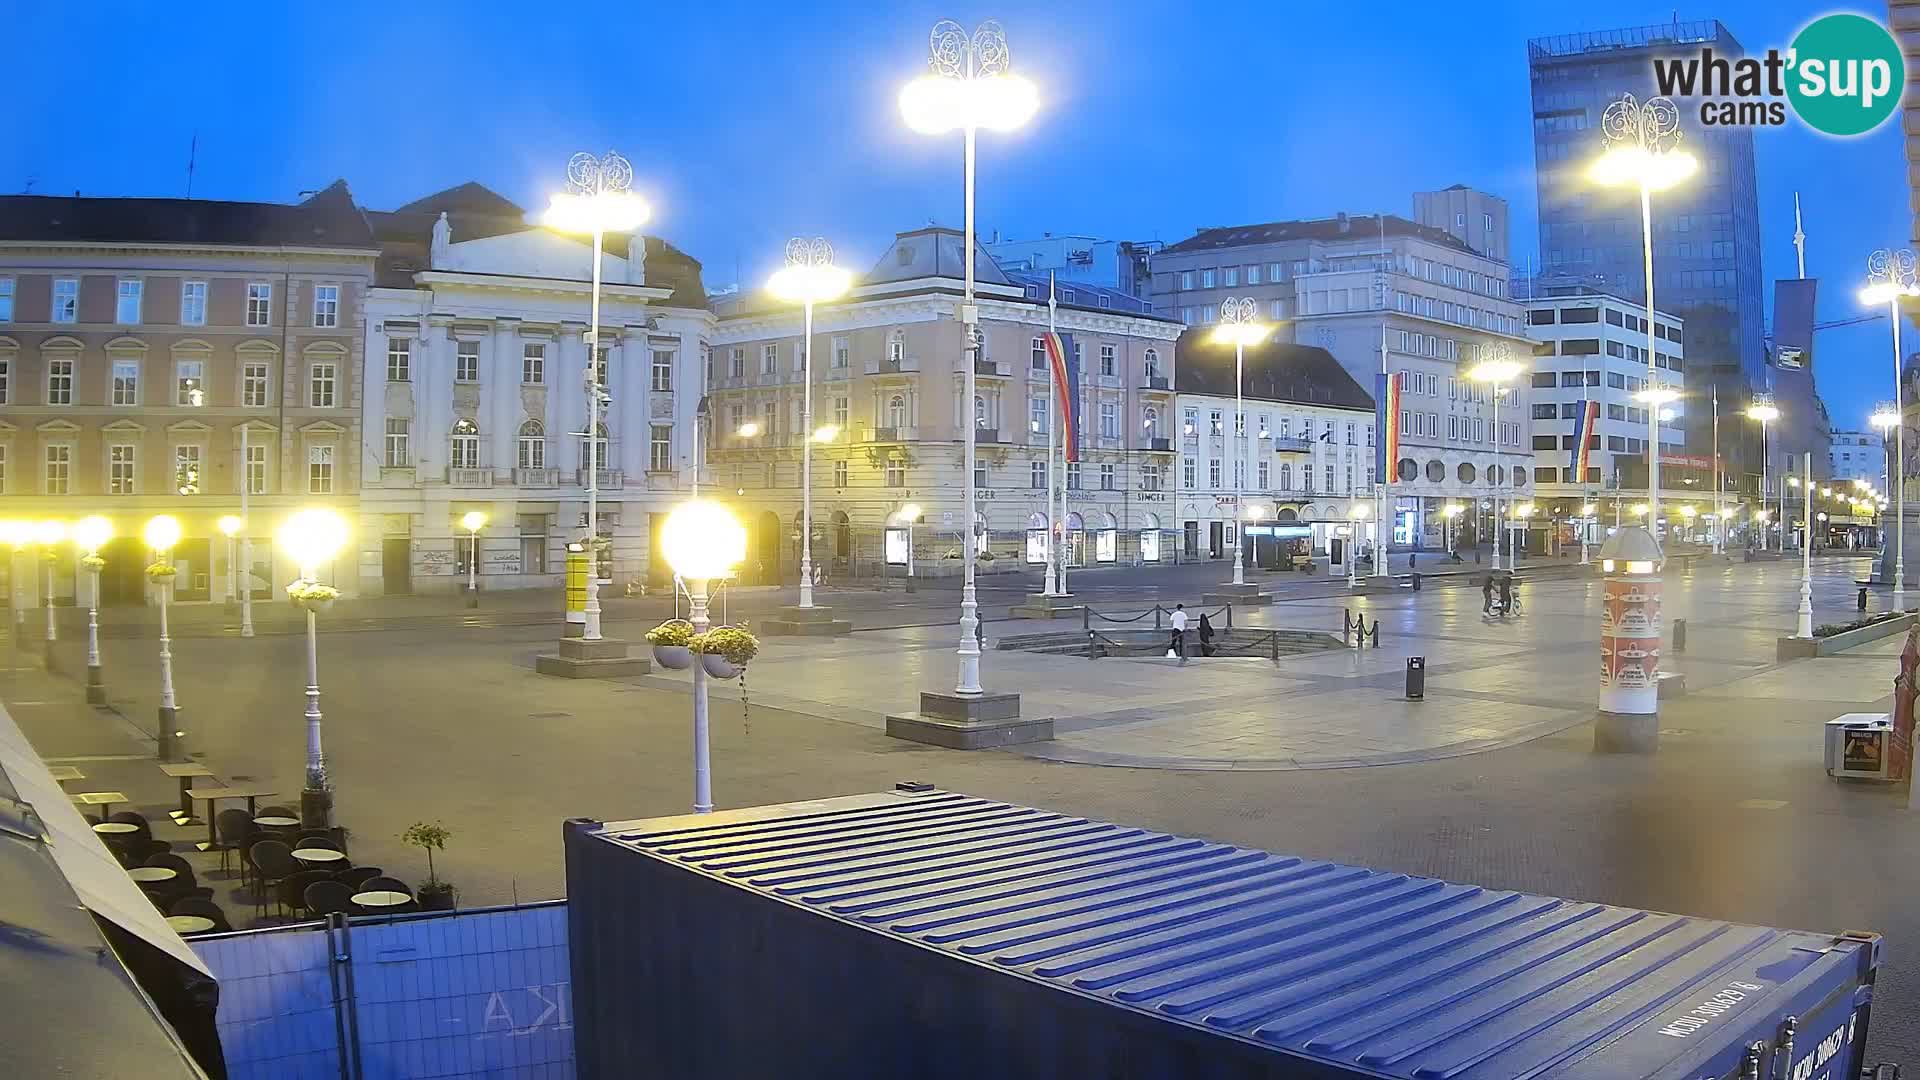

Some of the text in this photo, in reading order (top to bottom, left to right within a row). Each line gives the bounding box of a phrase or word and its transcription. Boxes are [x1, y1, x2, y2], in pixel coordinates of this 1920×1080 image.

[960, 490, 996, 500] SGER
[1137, 492, 1165, 502] SINGER
[1691, 989, 1747, 1017] 300629
